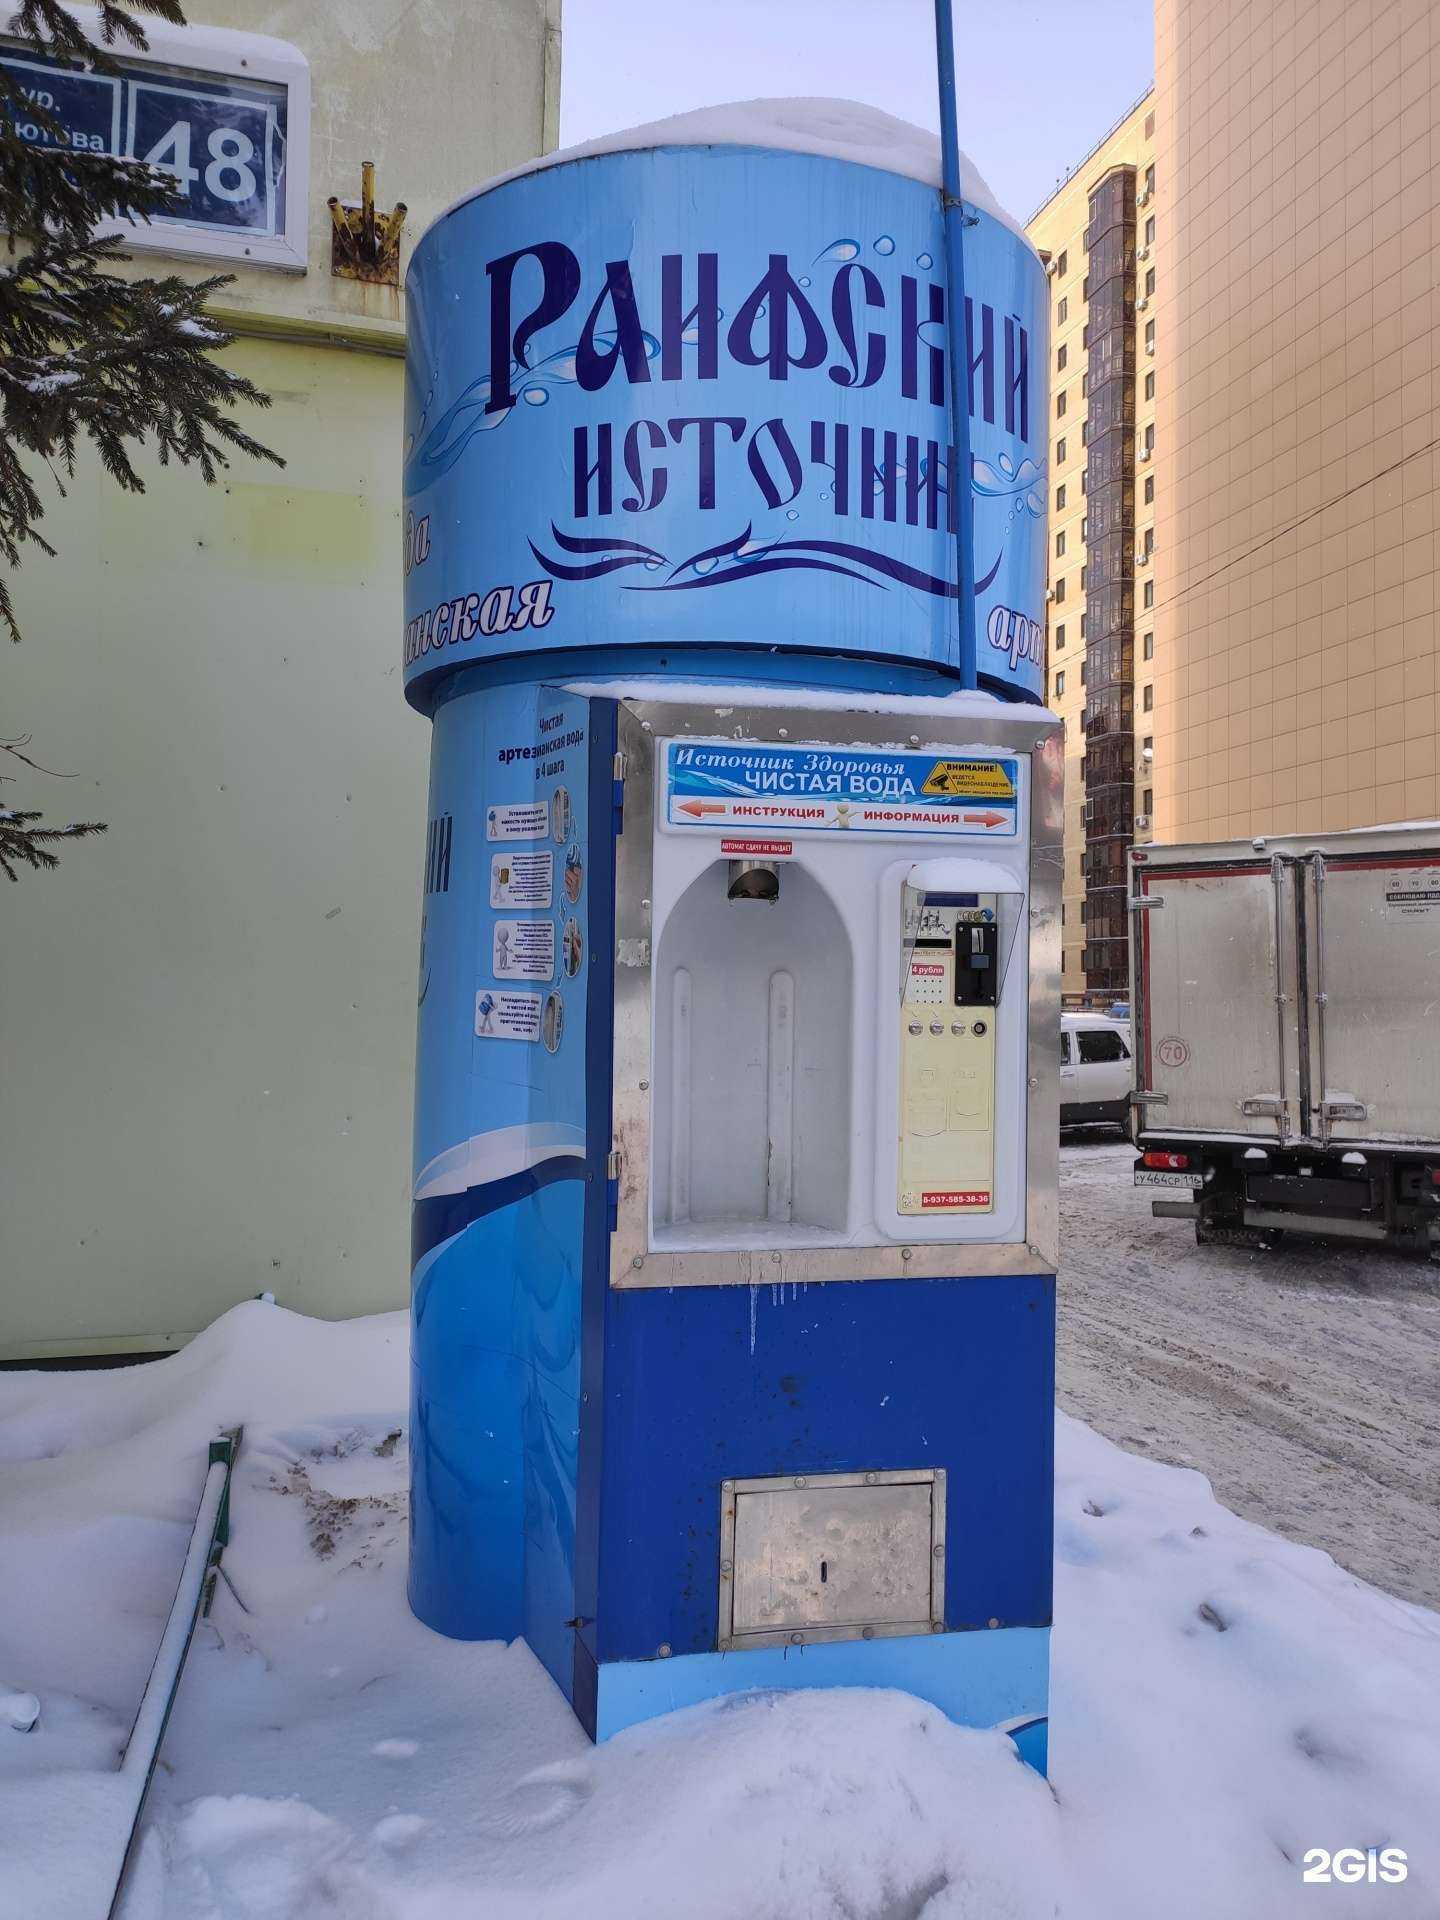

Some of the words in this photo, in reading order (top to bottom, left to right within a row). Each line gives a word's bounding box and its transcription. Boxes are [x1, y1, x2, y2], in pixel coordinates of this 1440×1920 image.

[142, 120, 257, 202] 48
[676, 747, 795, 771] Источник
[803, 753, 905, 776] Здоровья
[946, 763, 998, 773] ВНИМАНИЕ!
[745, 770, 842, 793] ЧИСТАЯ
[849, 775, 916, 799] ВОДА
[732, 805, 825, 819] ИНСТРУКЦИЯ
[863, 811, 960, 825] ИНФОРМАЦИЯ
[1162, 1045, 1183, 1061] 70
[1183, 1175, 1201, 1185] 116
